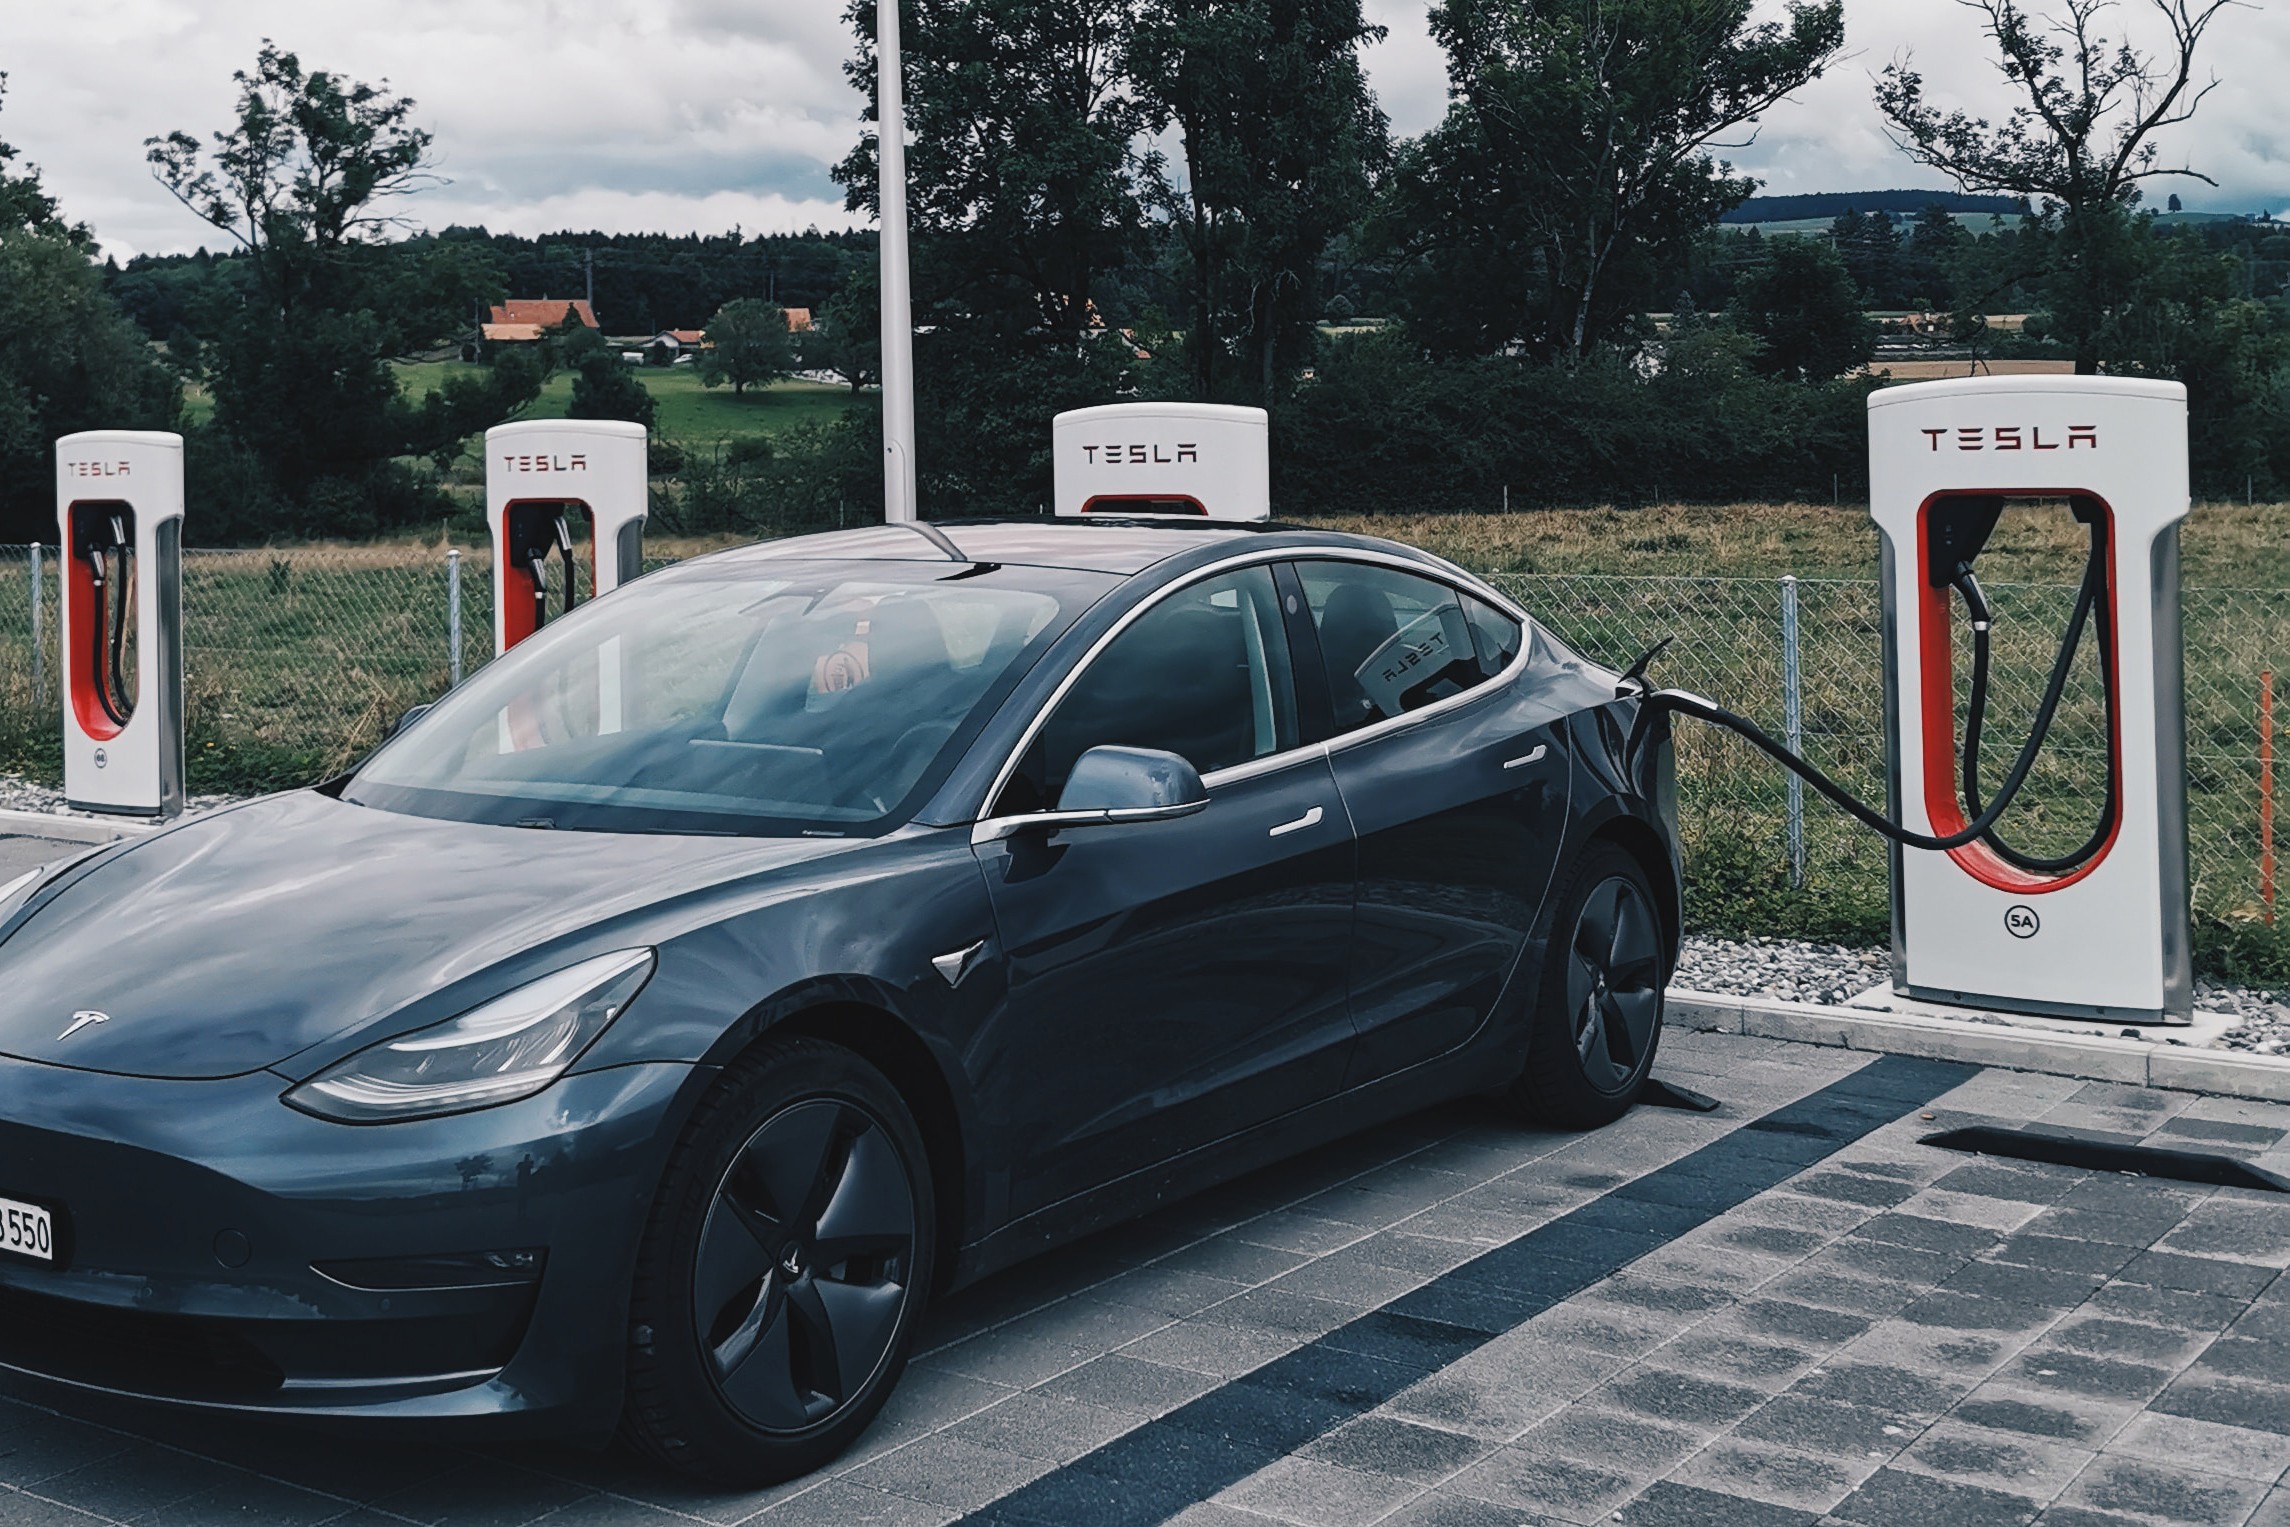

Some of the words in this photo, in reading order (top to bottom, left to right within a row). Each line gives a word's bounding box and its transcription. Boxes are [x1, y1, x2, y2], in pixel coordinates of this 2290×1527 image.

[1922, 425, 2097, 452] TESLA
[1083, 443, 1197, 464] TESLA
[67, 462, 131, 477] TESLA
[504, 454, 587, 473] TESLA
[2010, 914, 2034, 929] 5A
